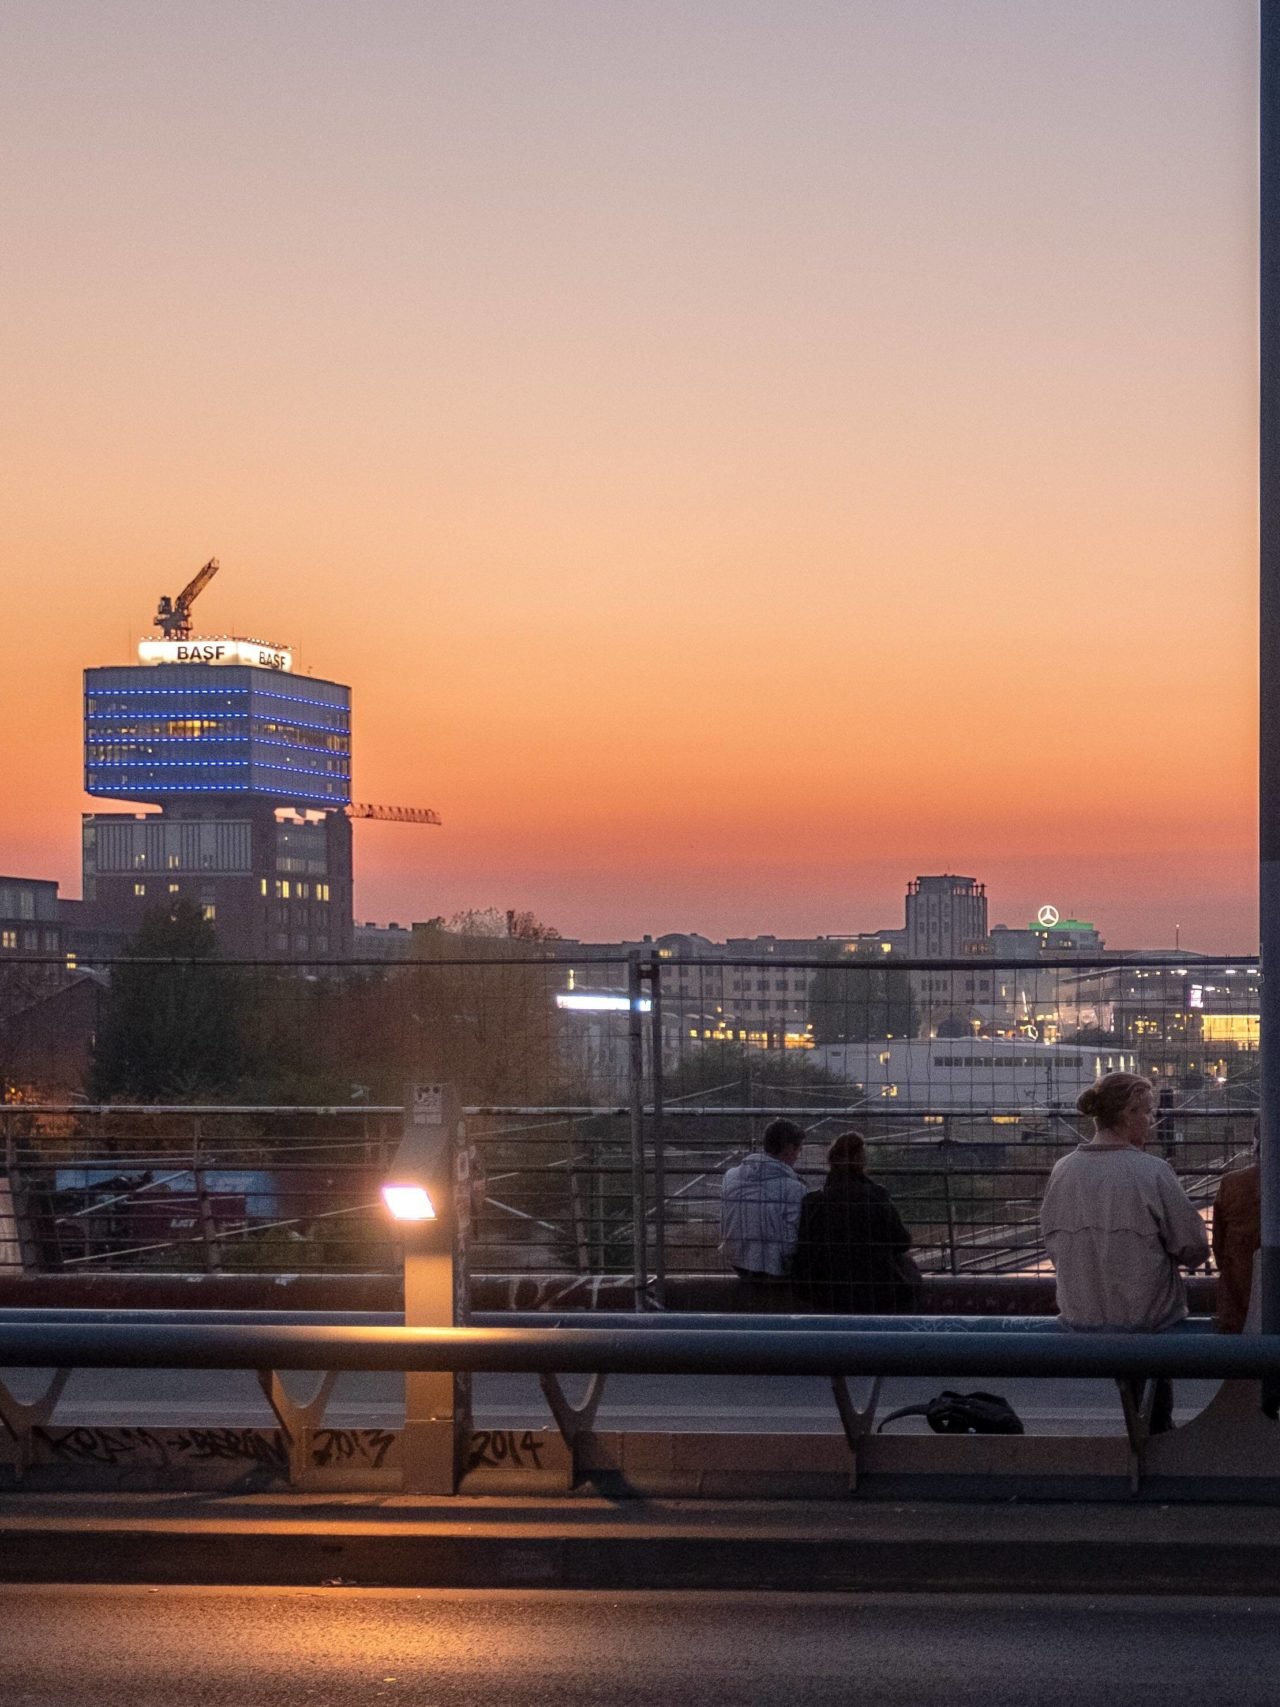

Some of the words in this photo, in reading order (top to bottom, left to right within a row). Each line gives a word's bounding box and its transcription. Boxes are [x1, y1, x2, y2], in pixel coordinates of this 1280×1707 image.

[177, 645, 226, 660] BASF
[259, 651, 286, 669] BASF
[312, 1429, 396, 1468] 2013
[468, 1430, 544, 1469] 2014
